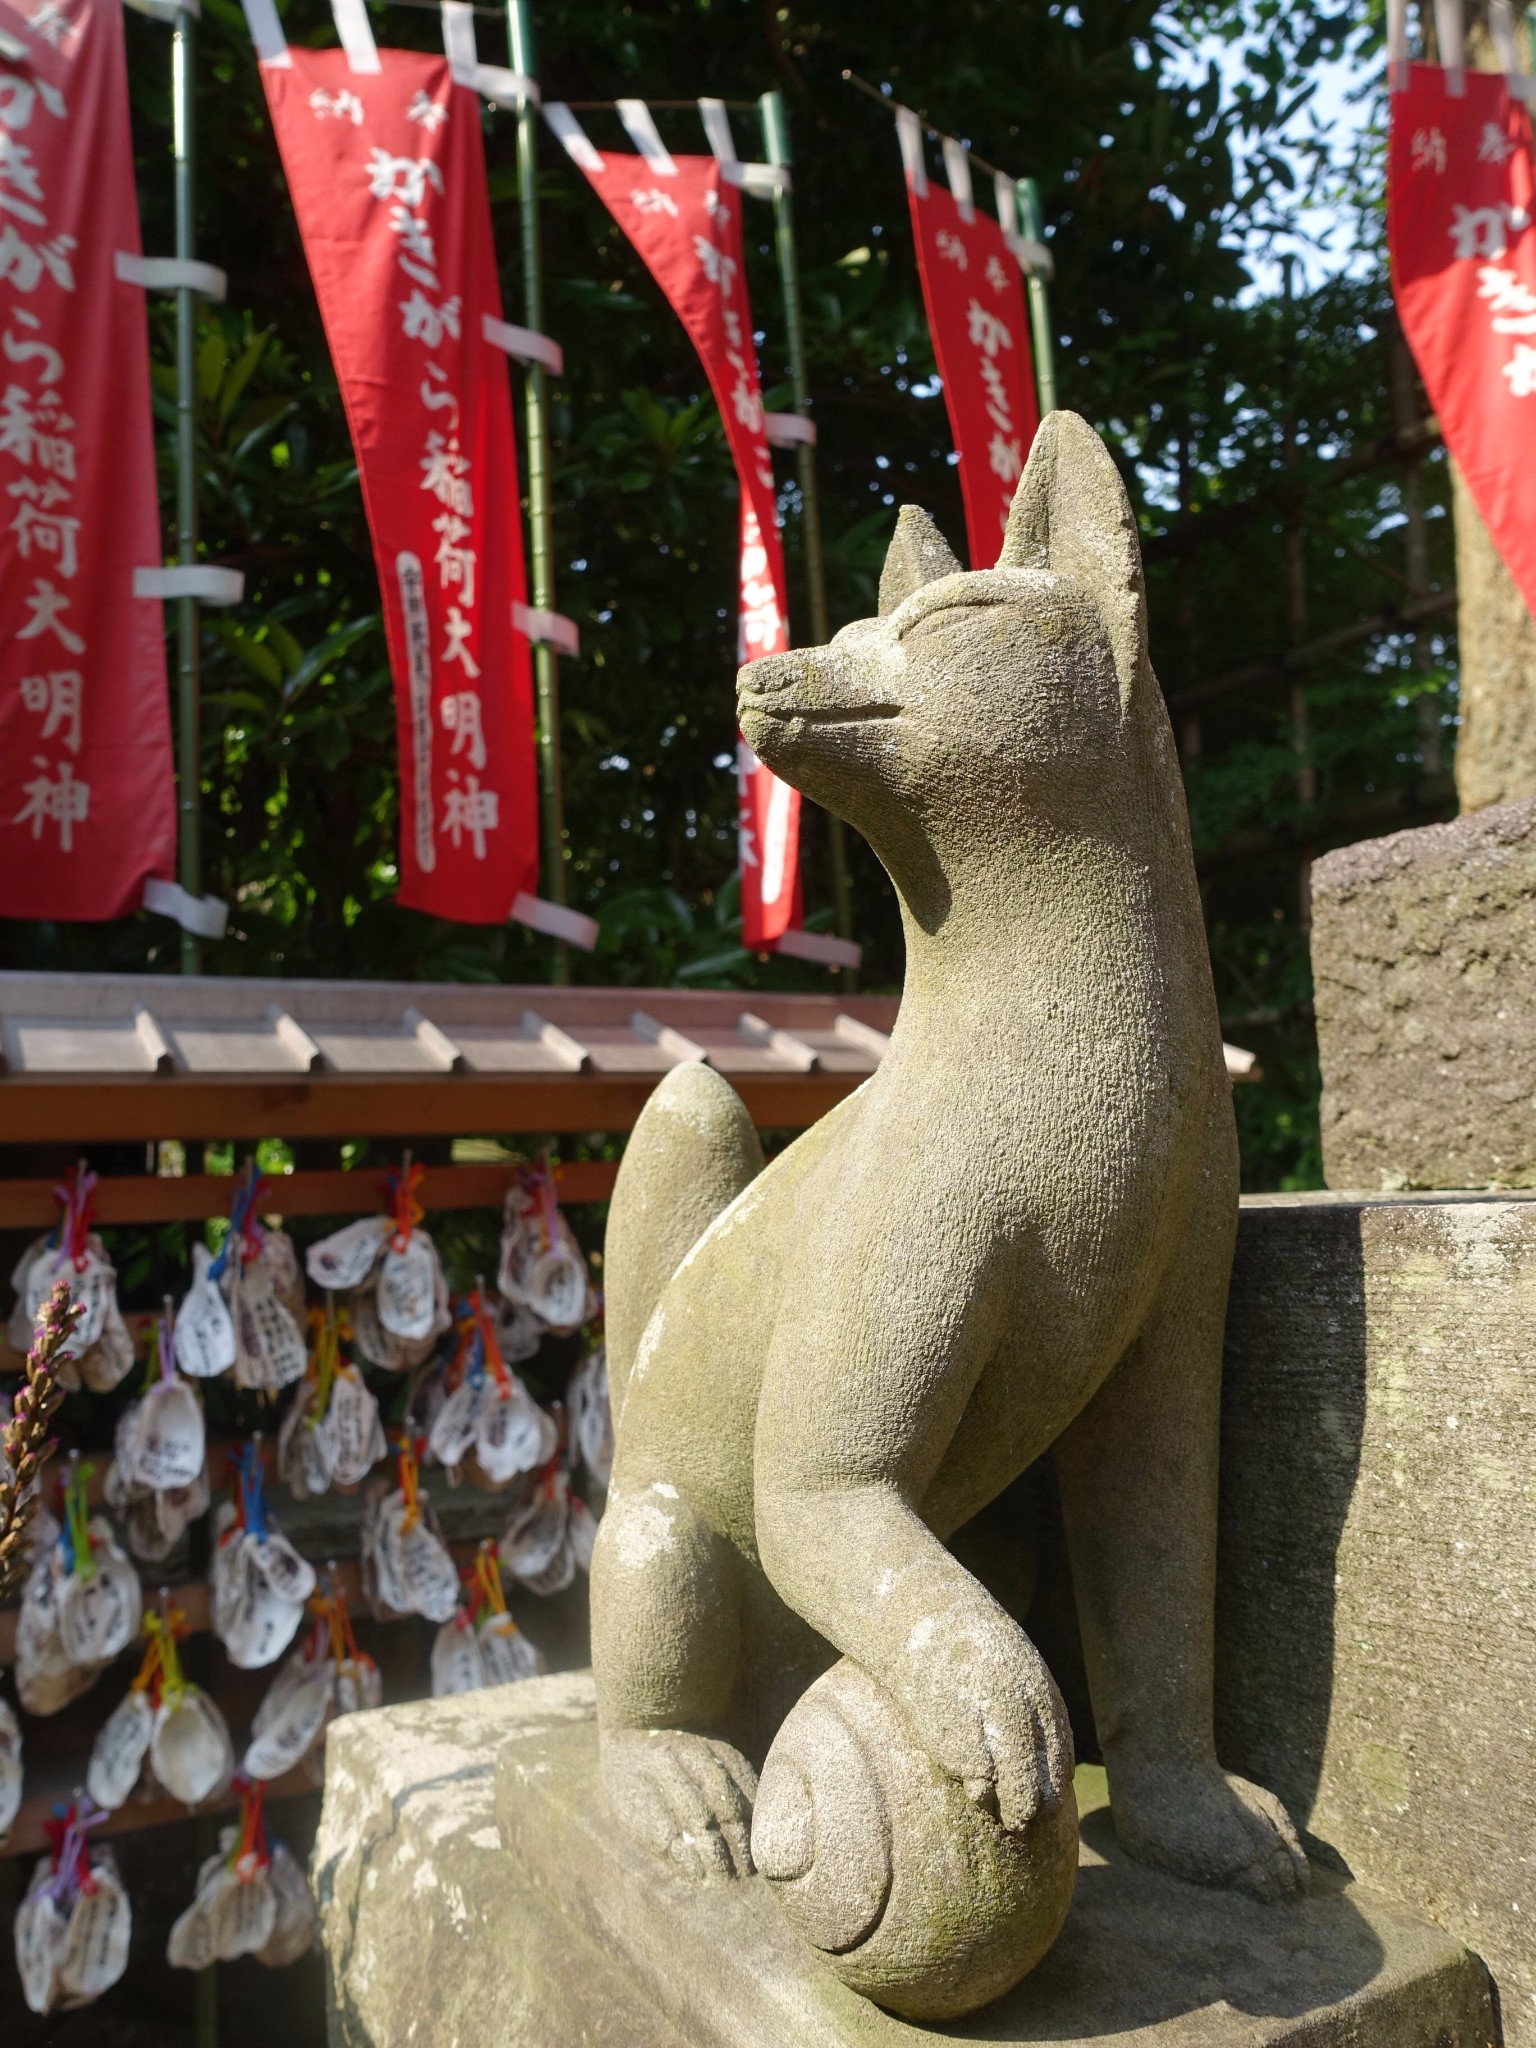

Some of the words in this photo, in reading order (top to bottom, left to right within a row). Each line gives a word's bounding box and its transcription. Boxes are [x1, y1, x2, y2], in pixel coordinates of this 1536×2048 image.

[365, 146, 498, 861] かきがら稲荷大明神
